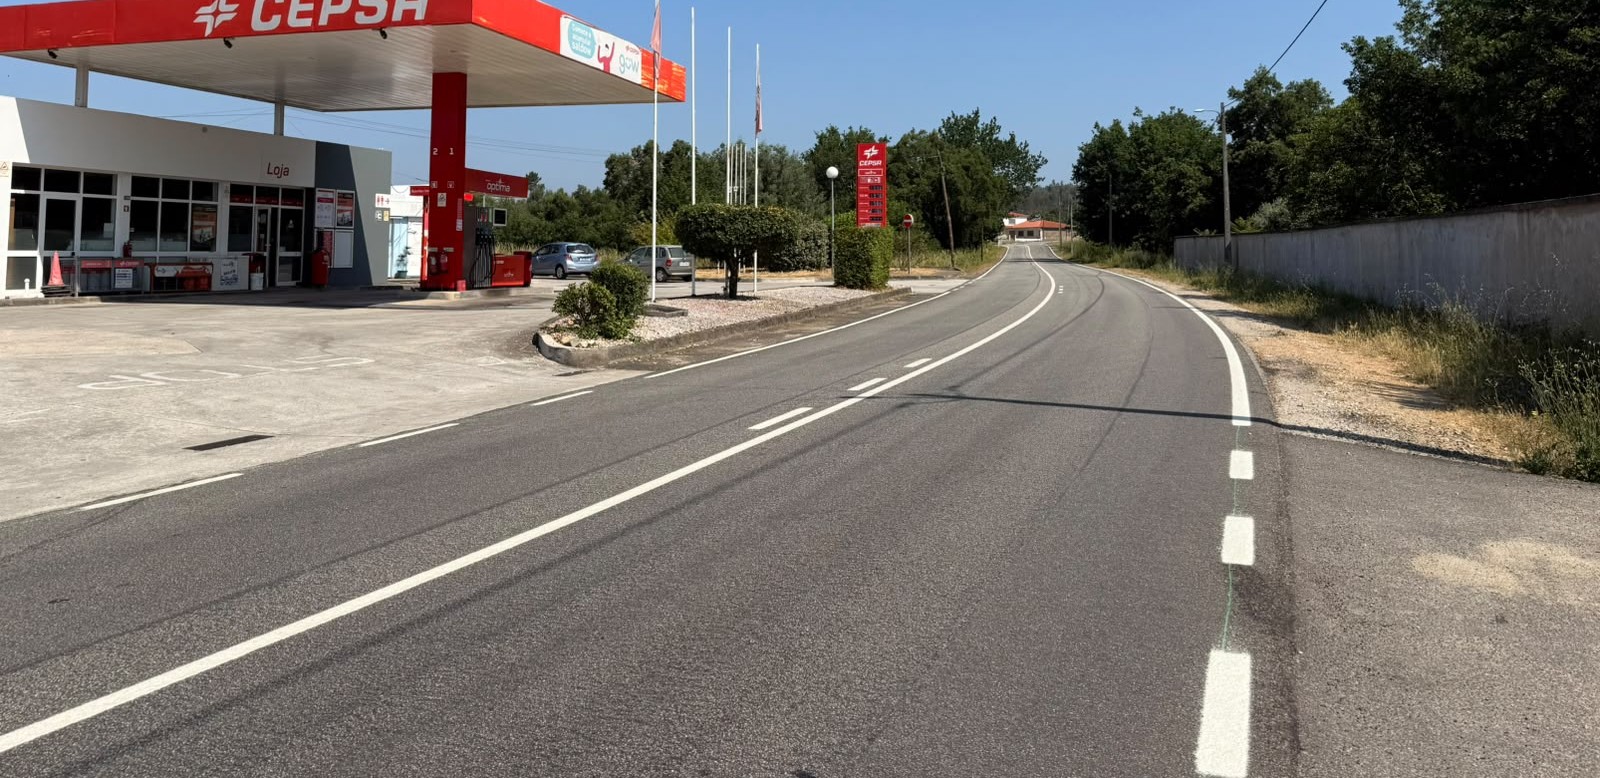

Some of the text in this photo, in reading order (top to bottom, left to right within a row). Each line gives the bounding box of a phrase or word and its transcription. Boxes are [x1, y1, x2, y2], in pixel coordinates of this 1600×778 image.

[251, 0, 427, 31] CEPSA
[267, 161, 290, 179] Loja
[486, 181, 511, 193] optima
